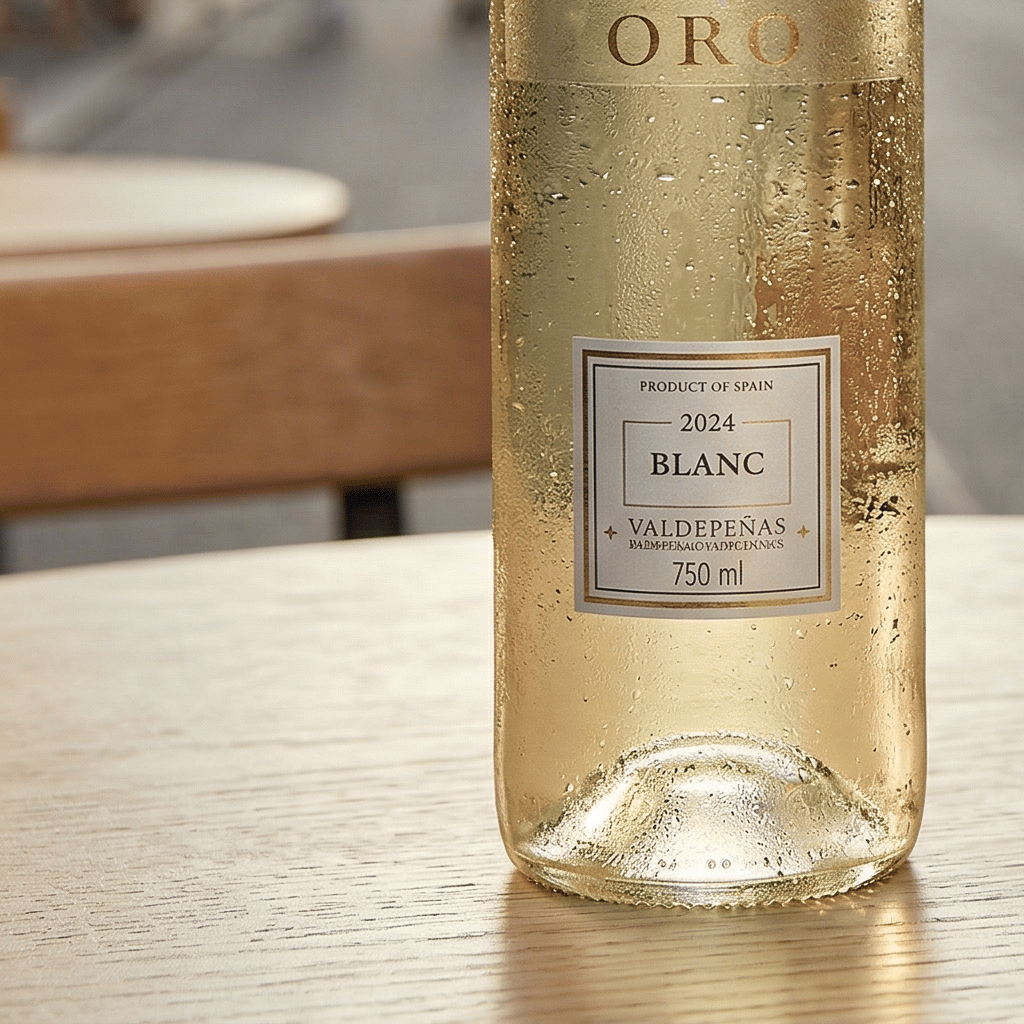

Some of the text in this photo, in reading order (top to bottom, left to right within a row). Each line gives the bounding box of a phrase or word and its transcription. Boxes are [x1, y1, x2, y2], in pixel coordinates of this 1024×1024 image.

[607, 13, 801, 67] ORO
[639, 379, 774, 393] PRODUCT OF SPAIN
[679, 413, 736, 432] 2024
[650, 451, 765, 476] BLANC
[627, 514, 786, 538] VALDEPEÑAS
[672, 559, 743, 586] 750 ml
